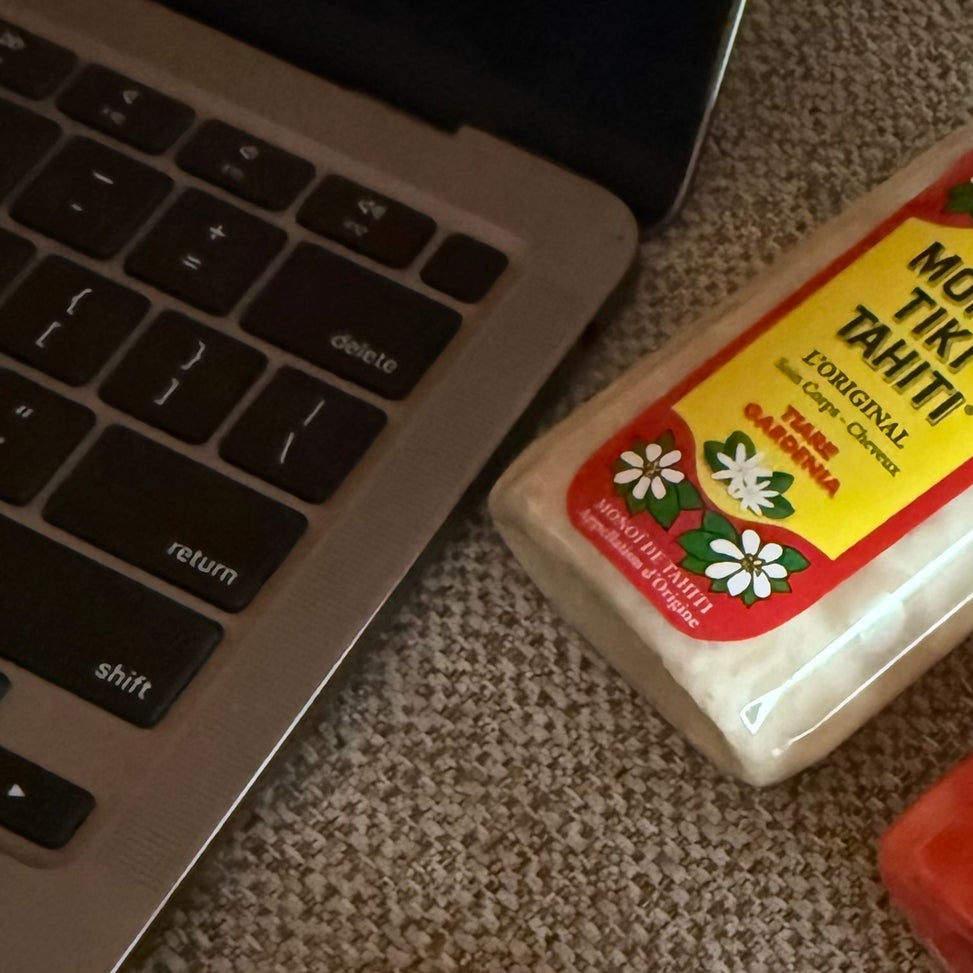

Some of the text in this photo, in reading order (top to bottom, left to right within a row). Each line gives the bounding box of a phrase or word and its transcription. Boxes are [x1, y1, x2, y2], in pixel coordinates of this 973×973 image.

[802, 349, 909, 450] L'ORIGINAL
[743, 402, 841, 500] GARDENIA
[781, 404, 840, 462] TIARE
[846, 422, 901, 478] Cheveux
[167, 540, 240, 587] return
[640, 541, 666, 565] DE
[663, 560, 714, 615] TAHITI
[641, 568, 700, 629] d'Origine
[94, 661, 153, 700] shift
